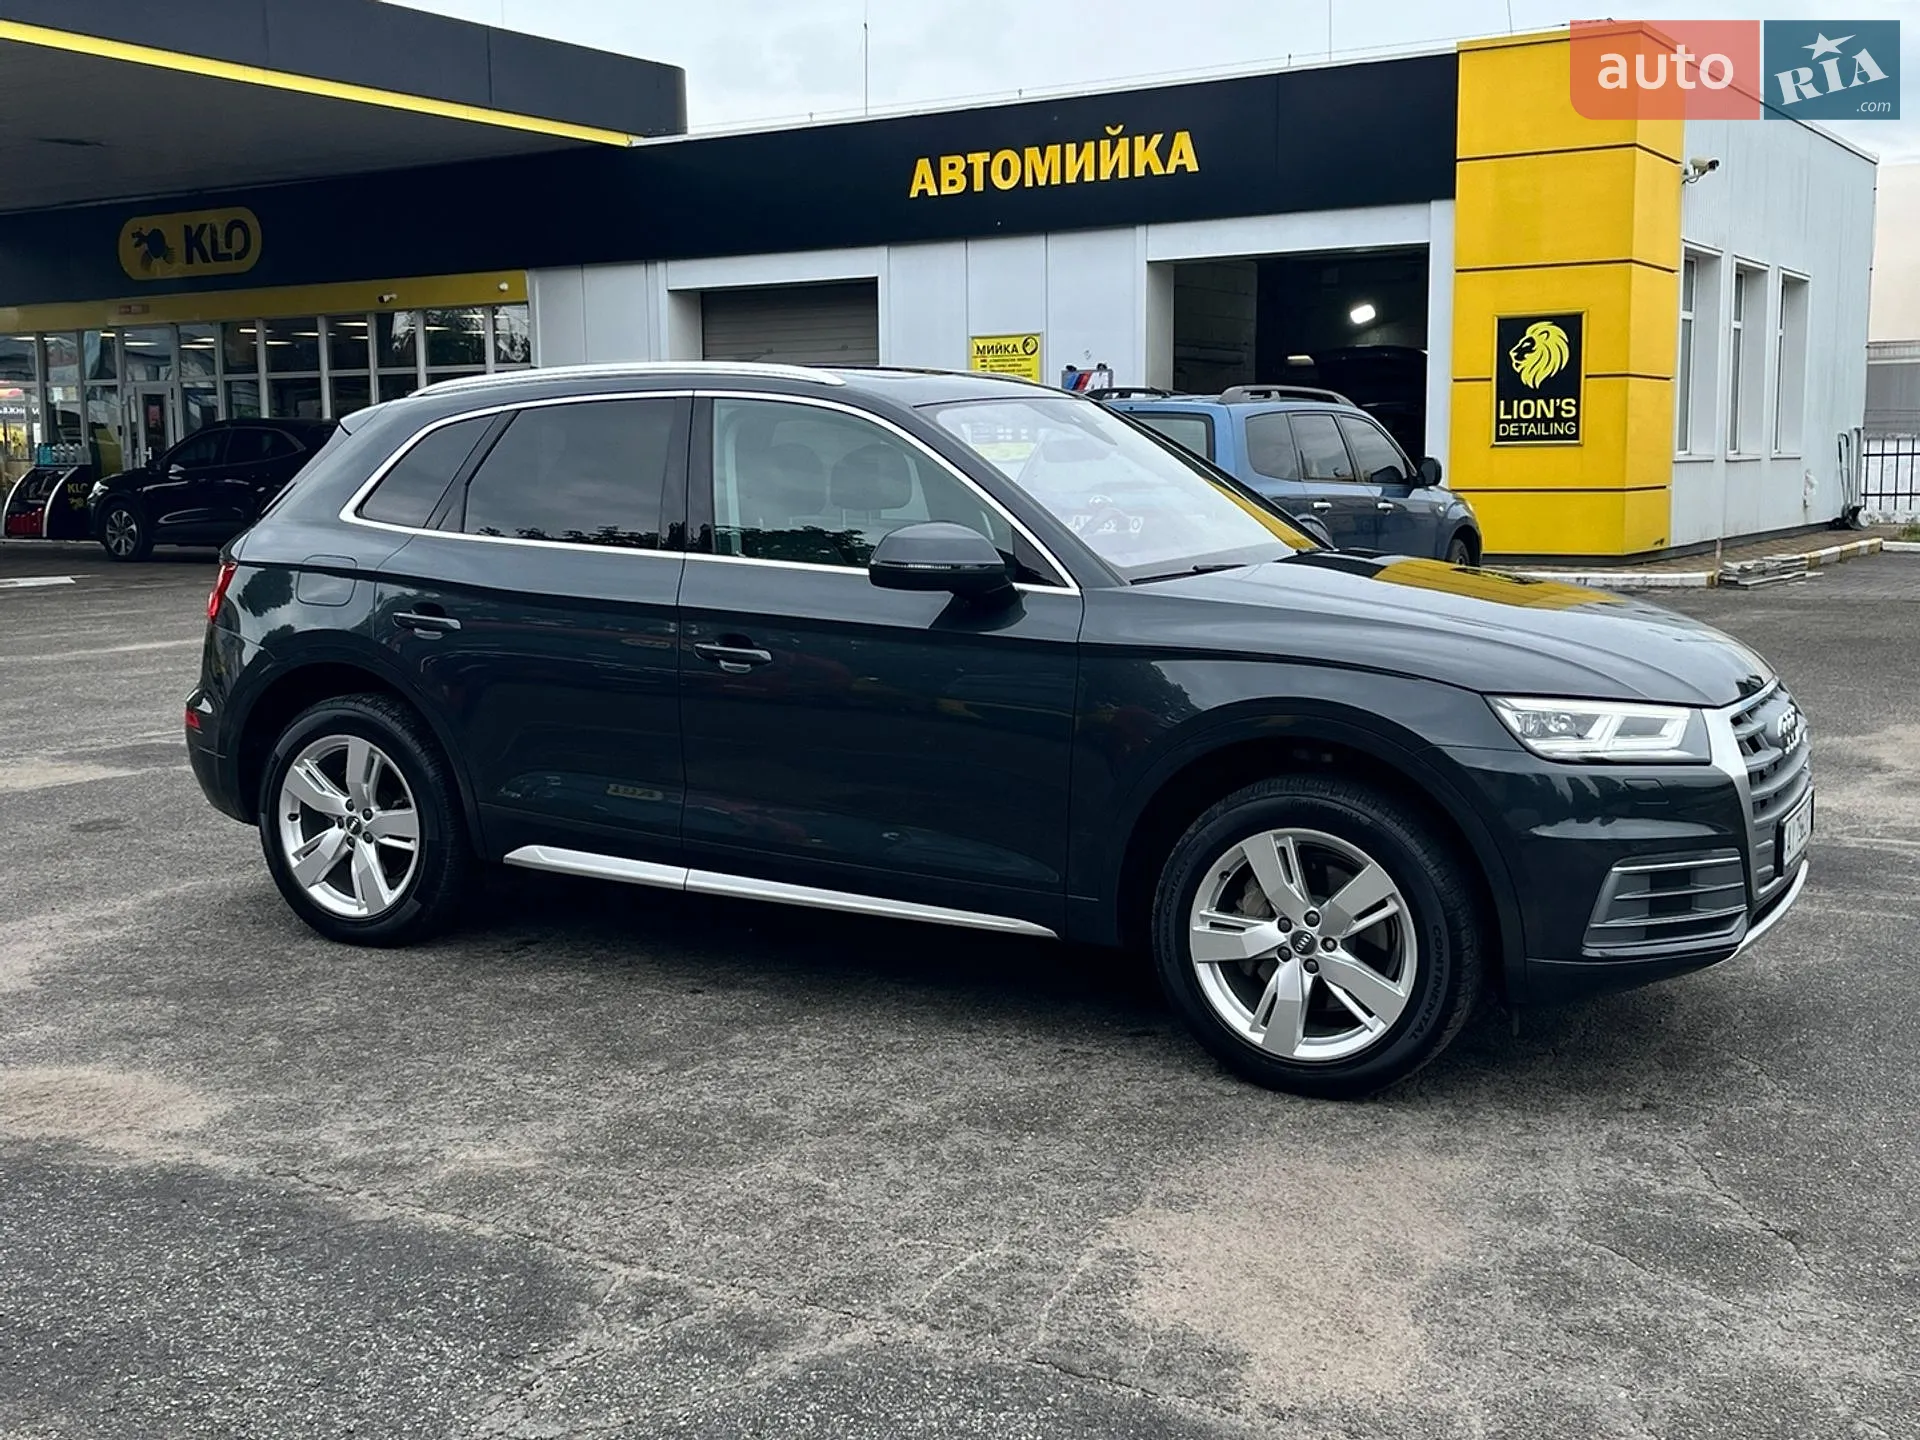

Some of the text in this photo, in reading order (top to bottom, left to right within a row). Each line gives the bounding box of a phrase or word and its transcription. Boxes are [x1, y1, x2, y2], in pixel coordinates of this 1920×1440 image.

[909, 124, 1200, 198] АВТОМИЙКА
[183, 219, 251, 265] KLO
[976, 342, 1019, 355] МИЙКА
[1499, 398, 1577, 420] LION'S
[1498, 421, 1577, 437] DETAILING
